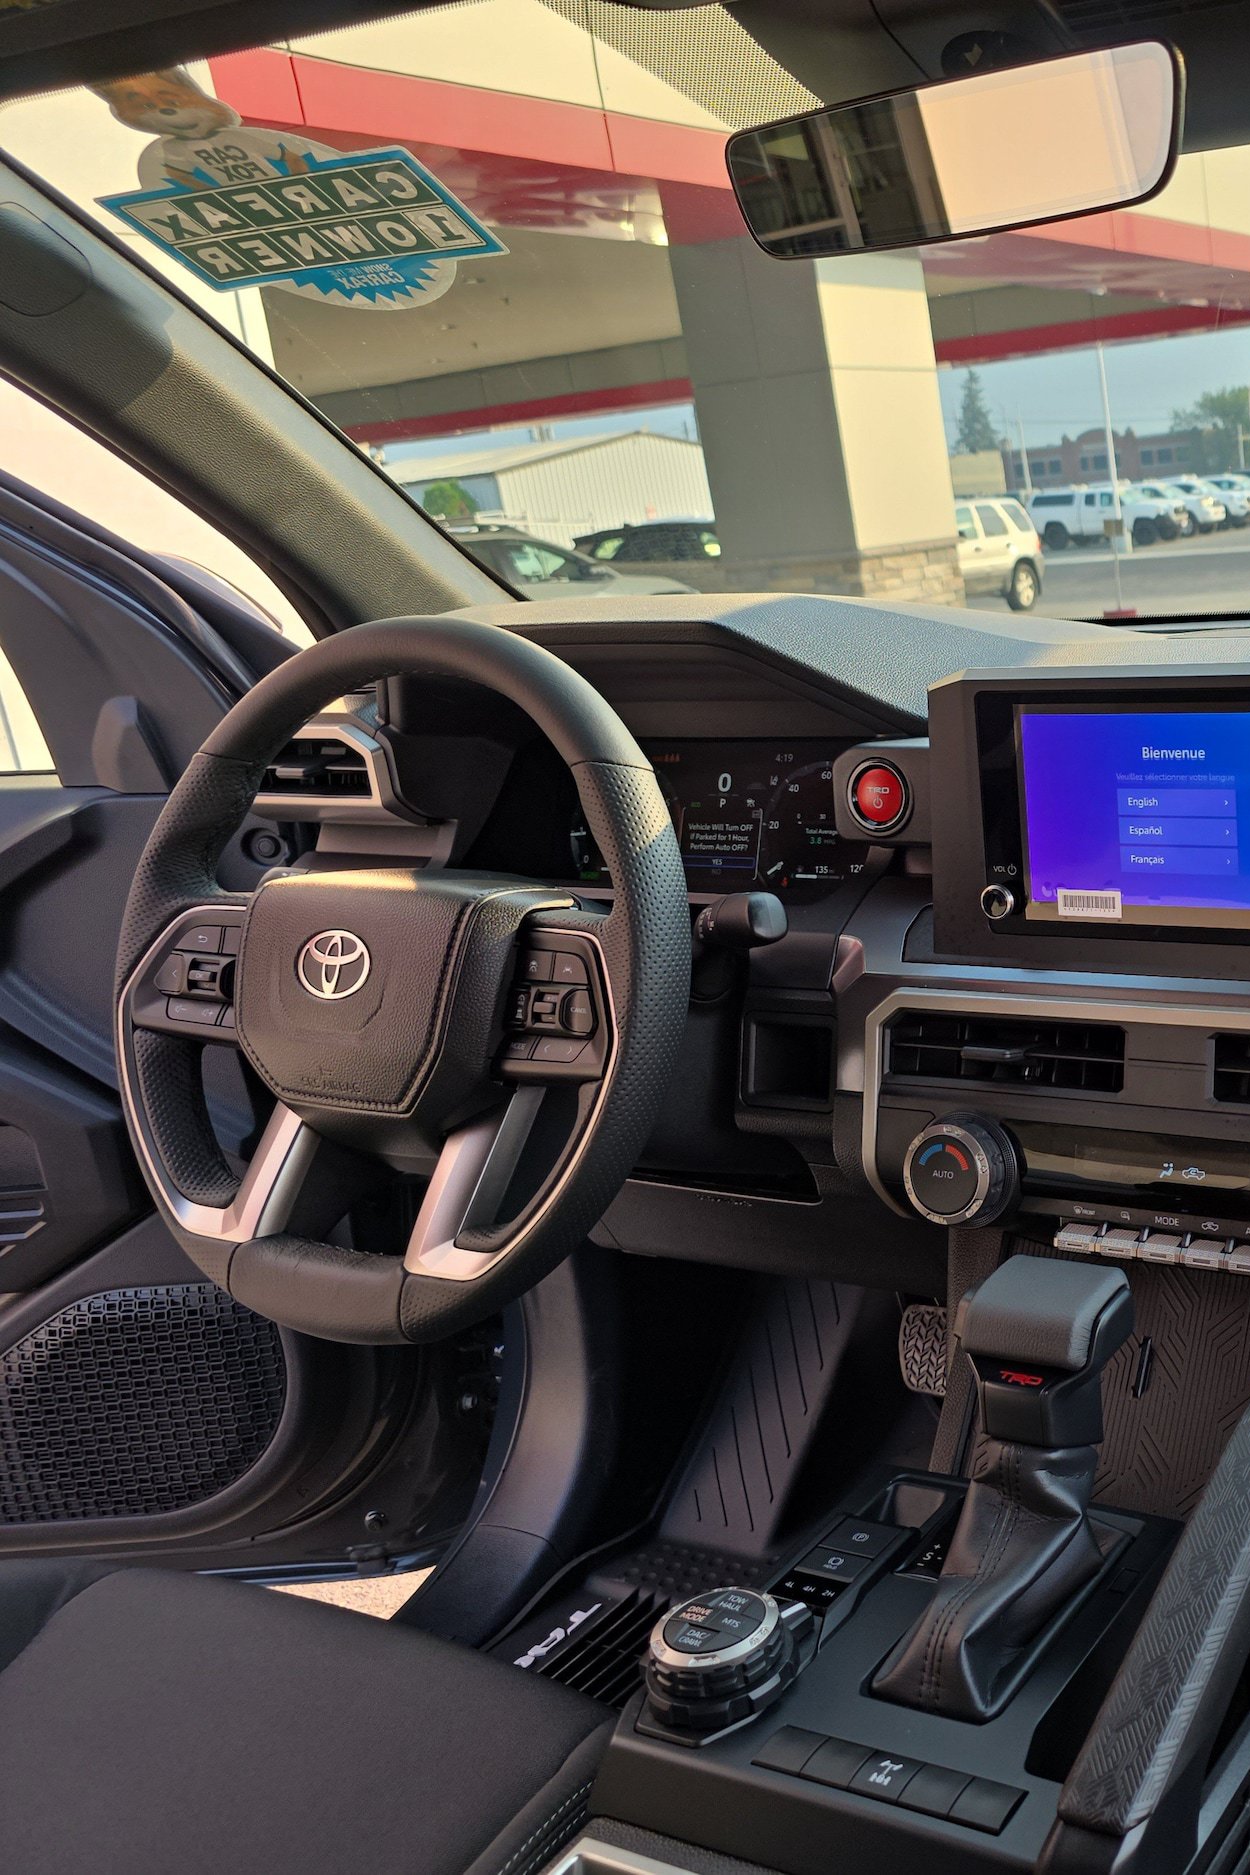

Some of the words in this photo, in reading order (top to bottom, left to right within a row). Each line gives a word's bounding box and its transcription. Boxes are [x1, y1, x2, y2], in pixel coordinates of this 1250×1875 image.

[1142, 746, 1206, 759] Bienvenue
[775, 754, 794, 762] 4:19
[821, 771, 832, 780] 60
[1209, 772, 1236, 783] langue
[717, 772, 733, 793] 0
[788, 784, 799, 793] 40
[866, 786, 890, 795] TRD
[719, 799, 727, 809] P
[1127, 797, 1158, 808] English
[688, 823, 711, 831] Vehicle
[725, 823, 739, 831] Turn
[768, 820, 779, 829] 20
[1129, 826, 1163, 836] Español
[718, 833, 727, 841] for
[690, 842, 714, 850] Perform
[715, 843, 731, 851] Auto
[731, 843, 749, 851] OFF?
[712, 858, 723, 866] YES
[1130, 854, 1165, 866] Français
[815, 865, 828, 874] 135
[993, 865, 1006, 873] VOL
[932, 1169, 954, 1179] AUTO
[1154, 1216, 1180, 1227] MODE
[1000, 1370, 1043, 1386] TRD
[922, 1551, 934, 1561] S
[785, 1580, 795, 1589] 4L
[802, 1585, 816, 1594] 4H
[821, 1589, 836, 1598] 2H
[728, 1594, 749, 1605] TOW
[687, 1604, 714, 1616] DRIVE
[719, 1600, 742, 1612] HAUL
[680, 1611, 706, 1622] MODE
[721, 1617, 741, 1628] MTS
[687, 1629, 711, 1639] DAC/
